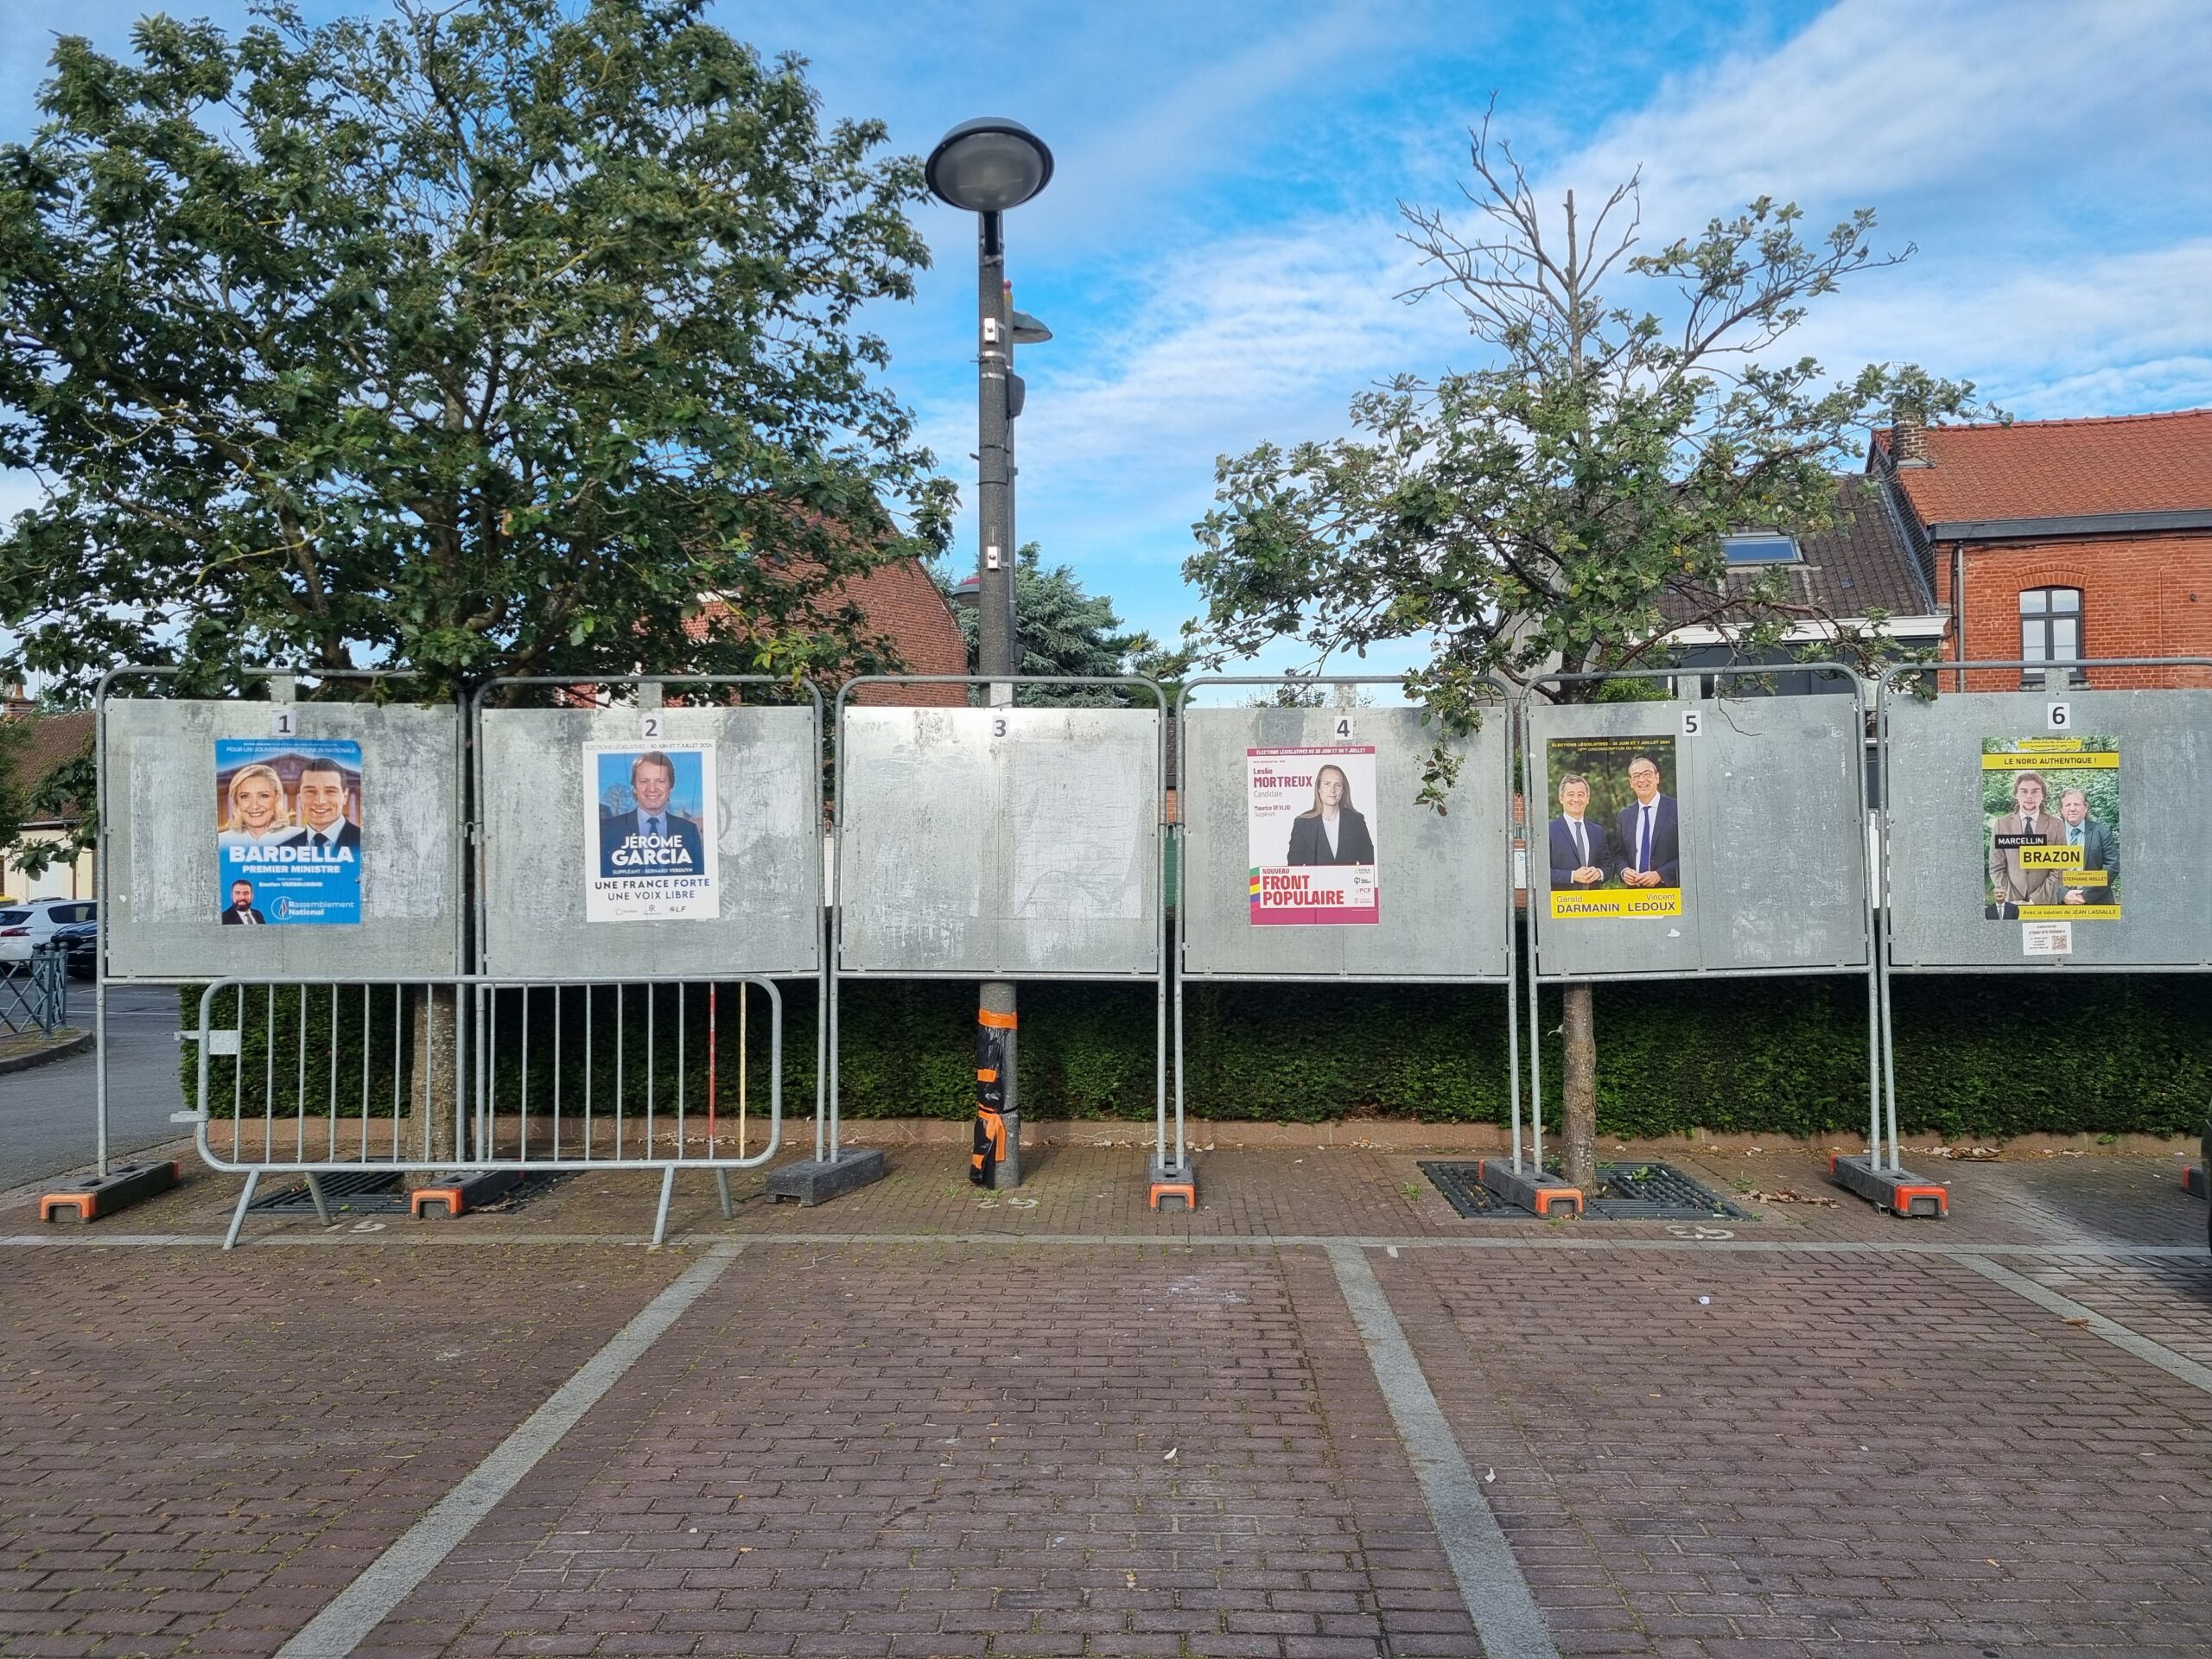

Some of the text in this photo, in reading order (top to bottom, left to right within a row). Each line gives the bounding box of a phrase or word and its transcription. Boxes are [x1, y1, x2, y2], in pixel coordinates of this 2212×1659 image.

[2052, 706, 2065, 724] 6
[278, 715, 290, 733] 1
[645, 719, 658, 736] 2
[994, 719, 1006, 737] 3
[1337, 720, 1350, 737] 4
[1685, 715, 1697, 733] 5
[1254, 776, 1313, 788] MORTREUX
[621, 833, 683, 849] JÉRÔME
[230, 846, 354, 862] BARDELLA
[612, 849, 693, 866] GARCIA
[2024, 851, 2080, 862] BRAZON
[595, 879, 710, 890] UNE FRANCE FORTE
[1263, 875, 1310, 890] FRONT
[608, 892, 630, 900] UNE
[666, 890, 695, 899] LIBRE
[1263, 891, 1344, 906] POPULAIRE
[1557, 904, 1619, 913] DARMANIN
[1628, 902, 1675, 912] LEDOUX
